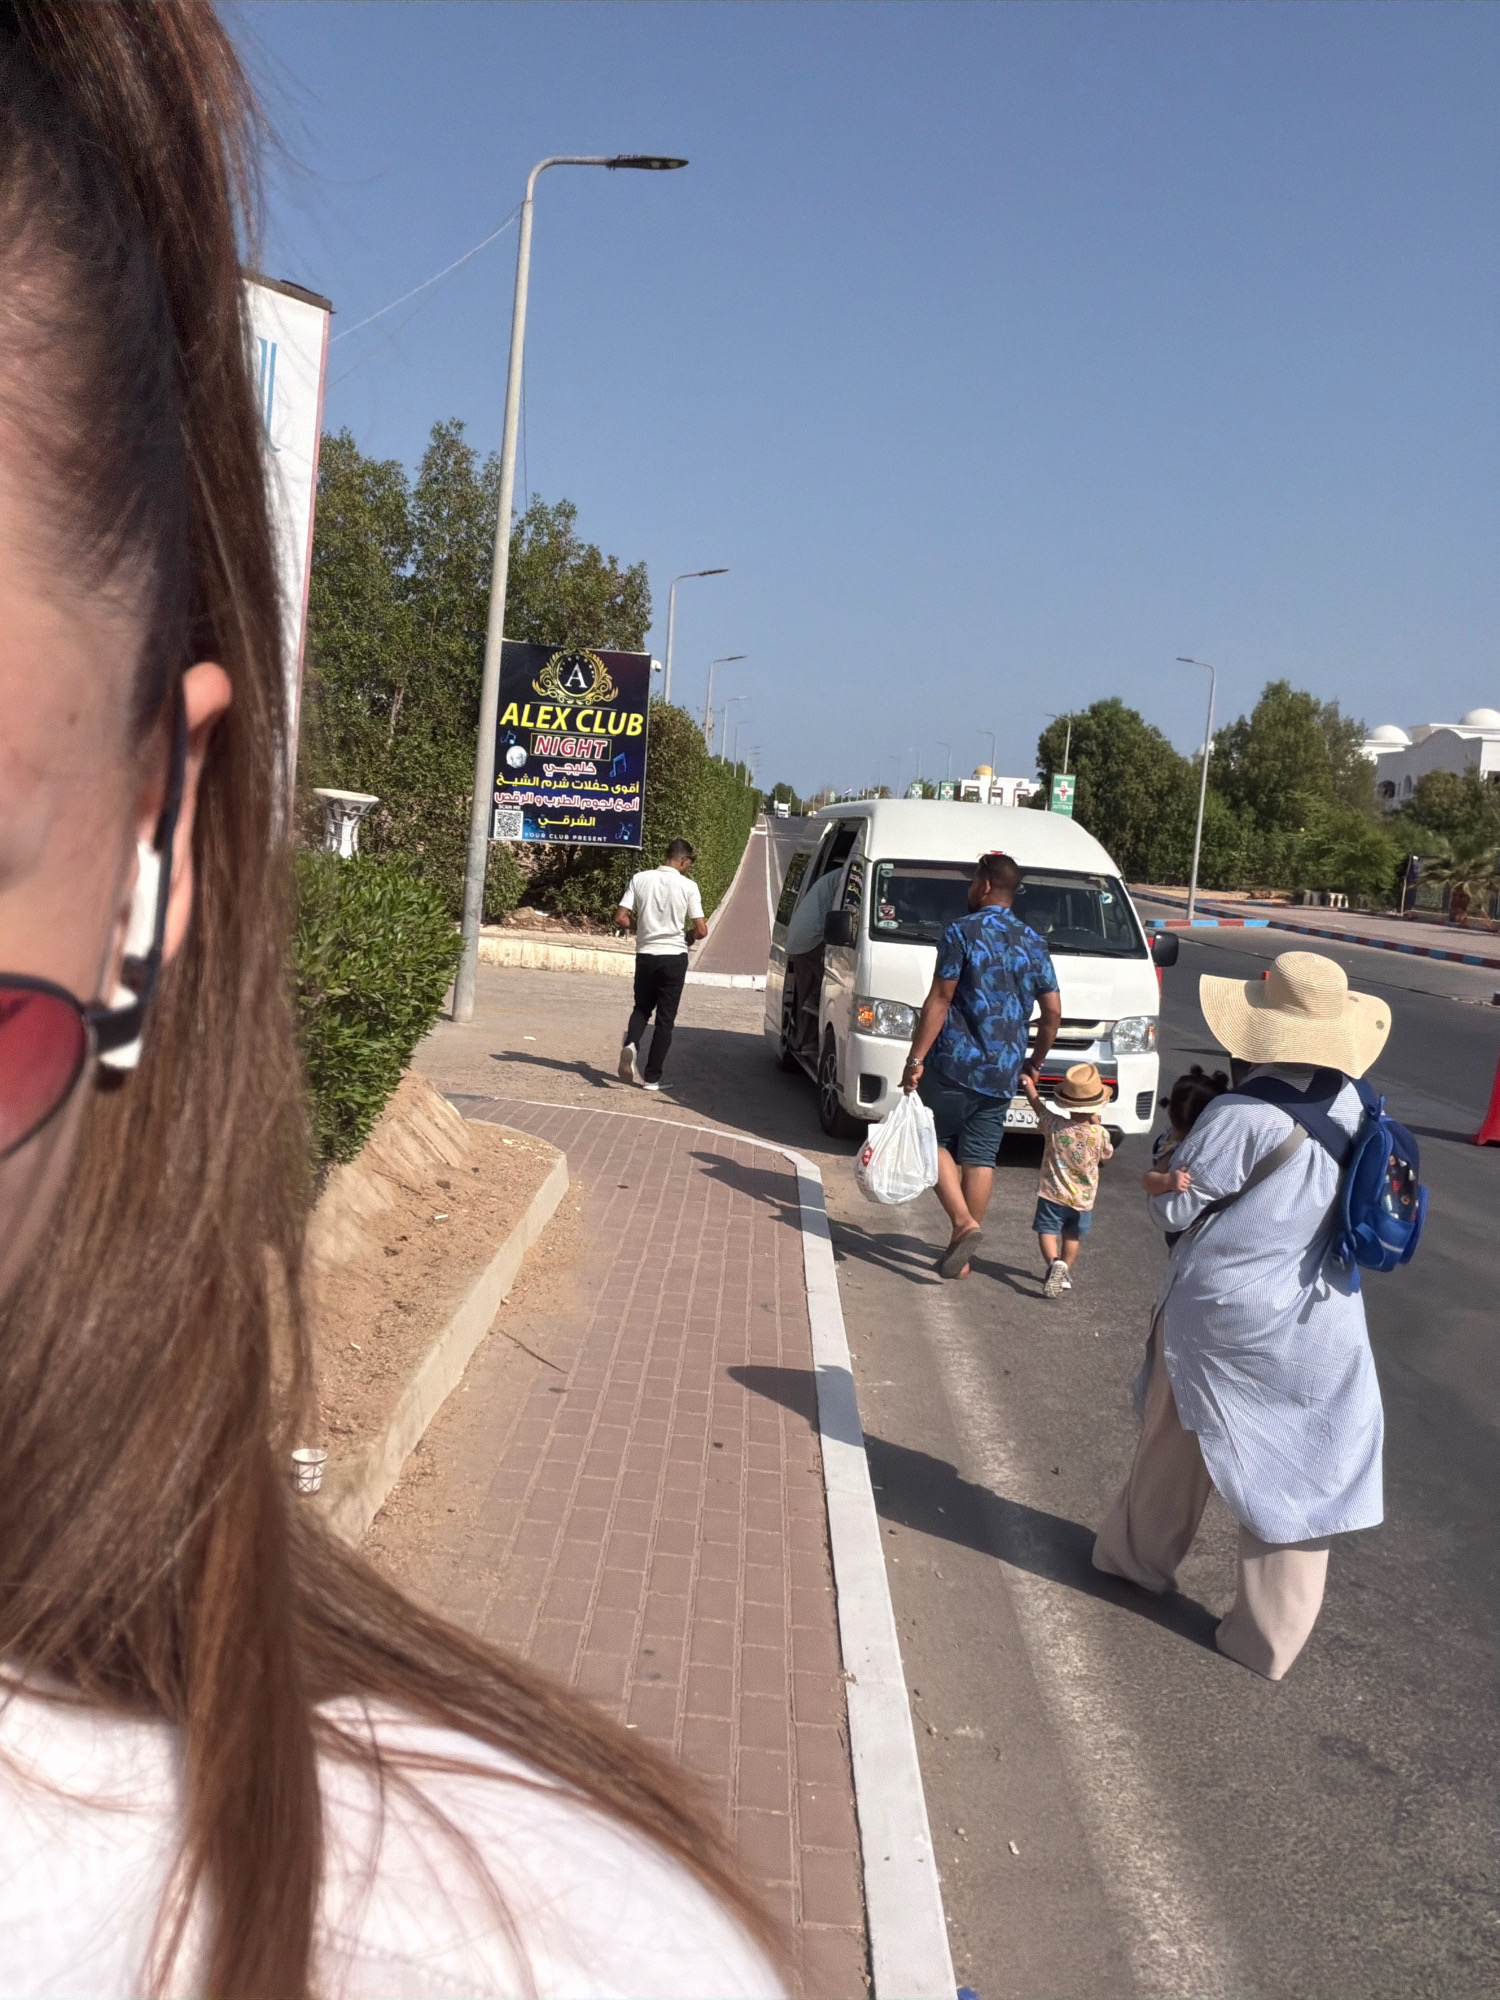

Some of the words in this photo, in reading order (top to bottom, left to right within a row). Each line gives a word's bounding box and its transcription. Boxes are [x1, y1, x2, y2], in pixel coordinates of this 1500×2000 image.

[564, 663, 588, 688] A
[499, 702, 572, 731] ALEX
[575, 709, 645, 737] CLUB
[533, 735, 608, 760] NIGHT
[542, 761, 598, 778] خليجي
[496, 772, 540, 787] الشيخ
[540, 776, 570, 790] شرم
[571, 779, 610, 792] حفلات
[610, 780, 640, 795] أقوى
[494, 790, 535, 806] الرقص
[534, 795, 544, 807] و
[543, 794, 581, 808] الطرب
[580, 797, 614, 811] نجوم
[537, 813, 596, 829] الشرقي
[548, 833, 570, 841] CLUB
[572, 834, 608, 843] PRESENT
